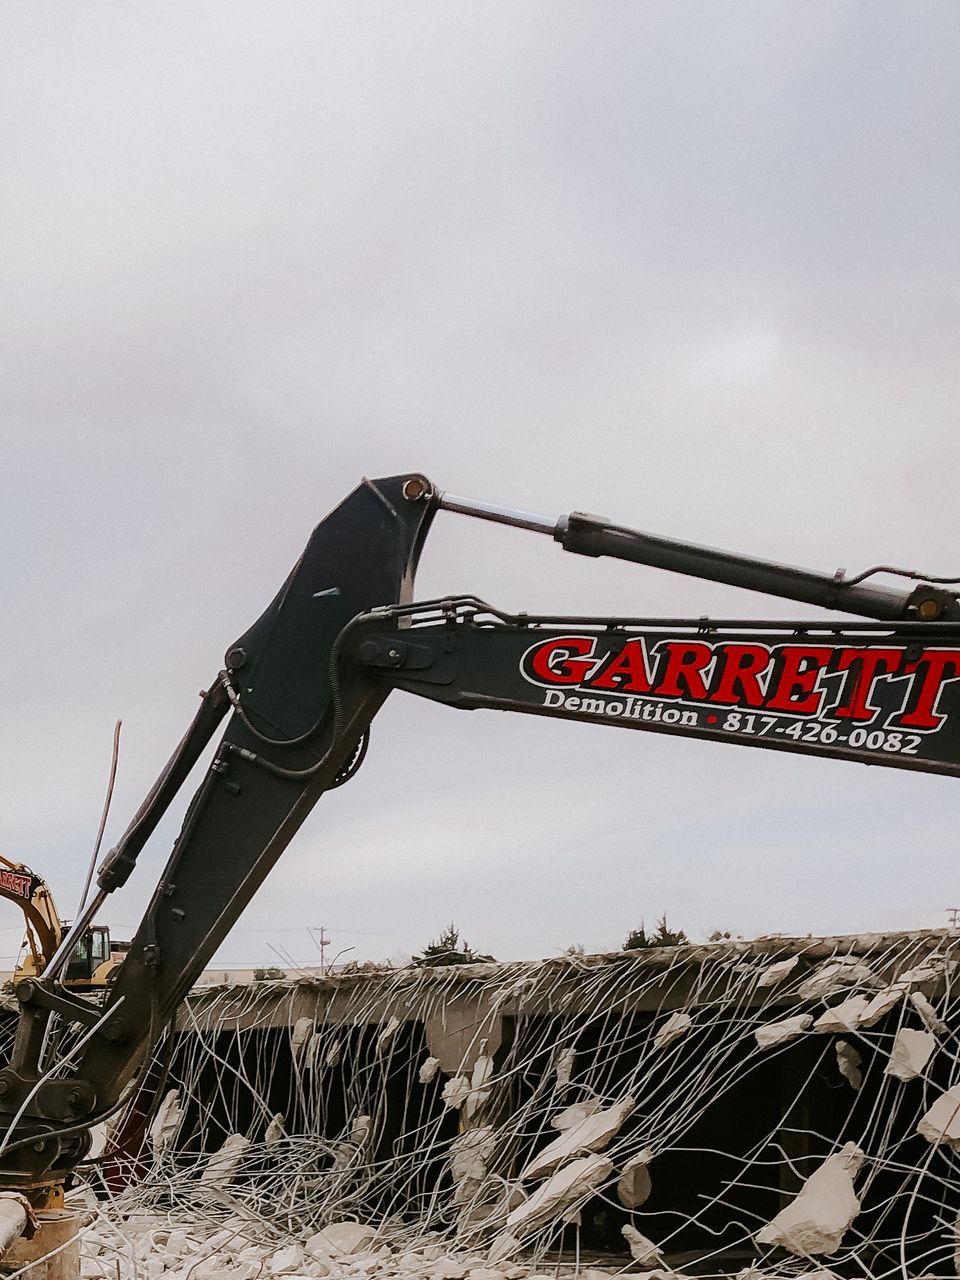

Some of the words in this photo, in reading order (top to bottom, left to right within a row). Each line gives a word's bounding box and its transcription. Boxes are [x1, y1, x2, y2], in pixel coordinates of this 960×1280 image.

[521, 635, 960, 734] GARRETT
[542, 689, 698, 727] Demolition
[721, 713, 922, 755] 817-426-0082
